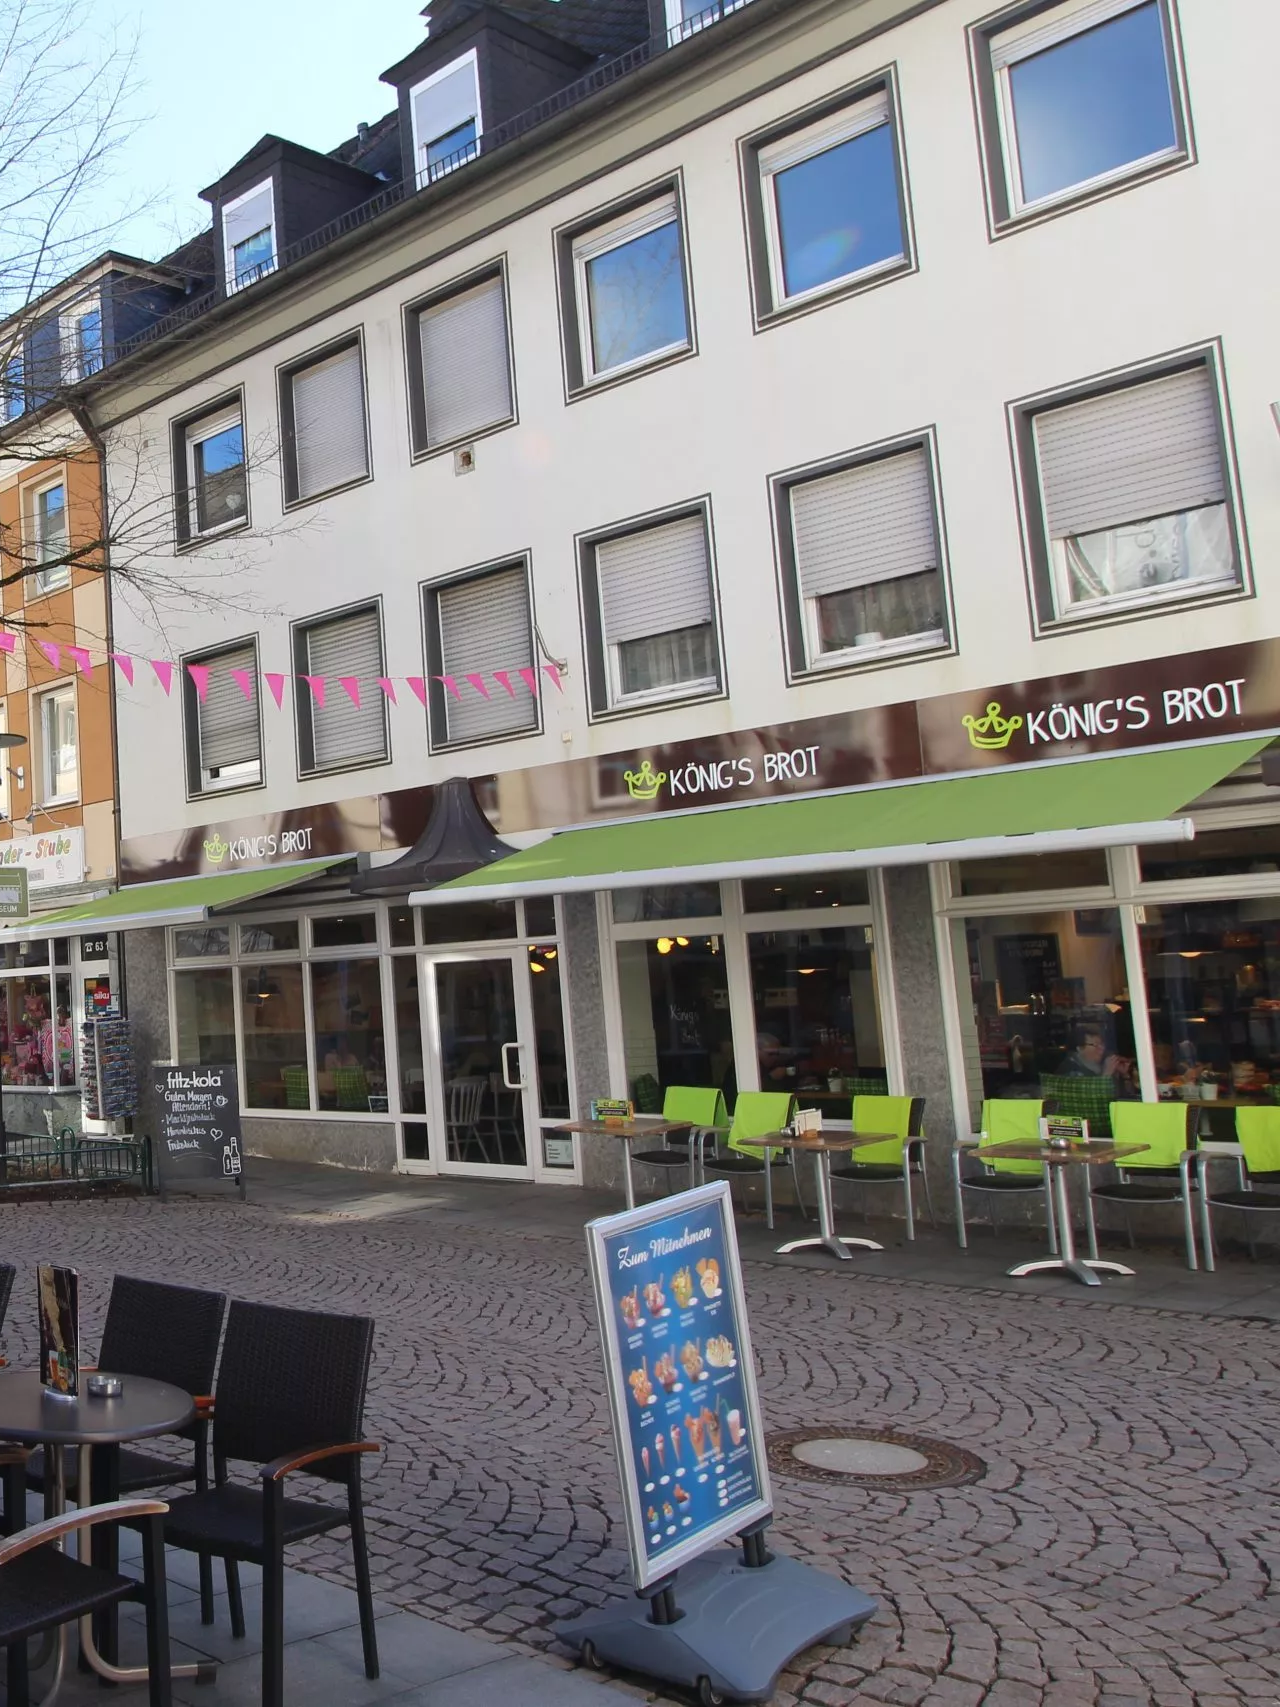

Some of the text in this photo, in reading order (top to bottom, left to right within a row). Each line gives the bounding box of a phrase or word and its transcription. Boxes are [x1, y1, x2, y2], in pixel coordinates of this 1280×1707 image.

[1026, 678, 1245, 745] KÖNIG'S BROT
[669, 745, 820, 796] KÖNIG'S BROT
[35, 834, 71, 859] Stube
[229, 827, 313, 862] KÖNIG'S BROT
[95, 941, 104, 952] 63
[93, 991, 110, 1000] siku
[167, 1070, 222, 1089] fritz-kola
[164, 1091, 213, 1104] Guten Morgen
[617, 1226, 712, 1270] Zum Mitnehmen
